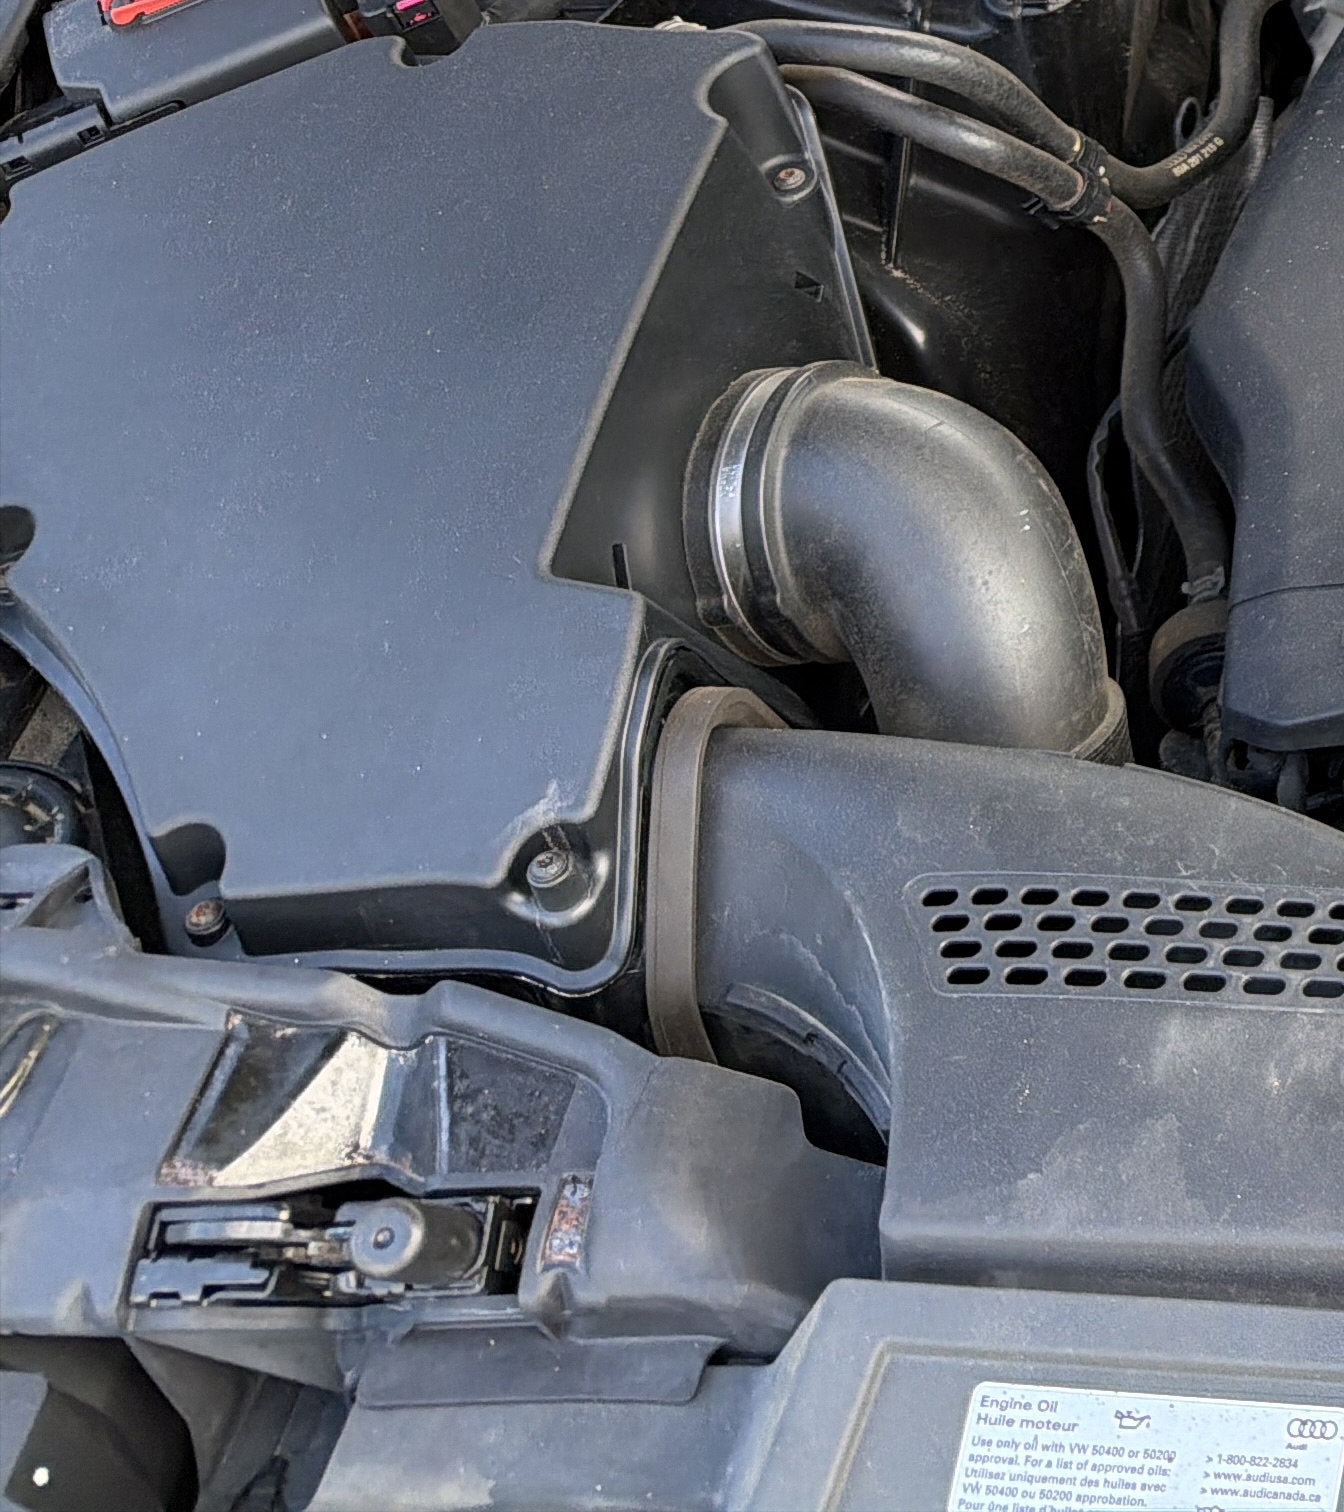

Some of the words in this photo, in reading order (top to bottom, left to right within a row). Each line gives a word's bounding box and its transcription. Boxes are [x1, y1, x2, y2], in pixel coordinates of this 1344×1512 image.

[980, 1395, 1033, 1412] Engine
[1037, 1399, 1059, 1413] Oil
[976, 1412, 1015, 1428] Huile
[1019, 1418, 1080, 1432] moteur
[971, 1435, 993, 1448] Use
[996, 1438, 1021, 1452] only
[1023, 1439, 1038, 1451] oil
[1041, 1441, 1065, 1453] with
[1069, 1443, 1090, 1455] VW
[1092, 1444, 1125, 1458] 50400
[1128, 1449, 1140, 1459] or
[1143, 1448, 1177, 1462] 50200
[1285, 1442, 1308, 1451] Audi
[968, 1453, 1021, 1467] approval.
[1024, 1455, 1043, 1468] For
[1045, 1460, 1053, 1469] a
[1056, 1458, 1073, 1470] list
[1076, 1459, 1089, 1471] of
[1091, 1461, 1144, 1476] approved
[1217, 1453, 1299, 1469] 1-800-822-2834
[964, 1467, 1005, 1481] Utilisez
[1009, 1471, 1077, 1487] uniquement
[1080, 1475, 1100, 1488] des
[1103, 1476, 1137, 1490] huiles
[1140, 1483, 1167, 1493] avec
[1213, 1471, 1316, 1486] www.audiusa.com
[962, 1482, 983, 1495] VW
[985, 1485, 1018, 1498] 50400
[1021, 1490, 1036, 1499] ou
[1039, 1488, 1073, 1502] 50200
[1075, 1493, 1148, 1507] approbation.
[1210, 1487, 1322, 1503] www.audicanada.ca
[958, 1498, 985, 1510] Pour
